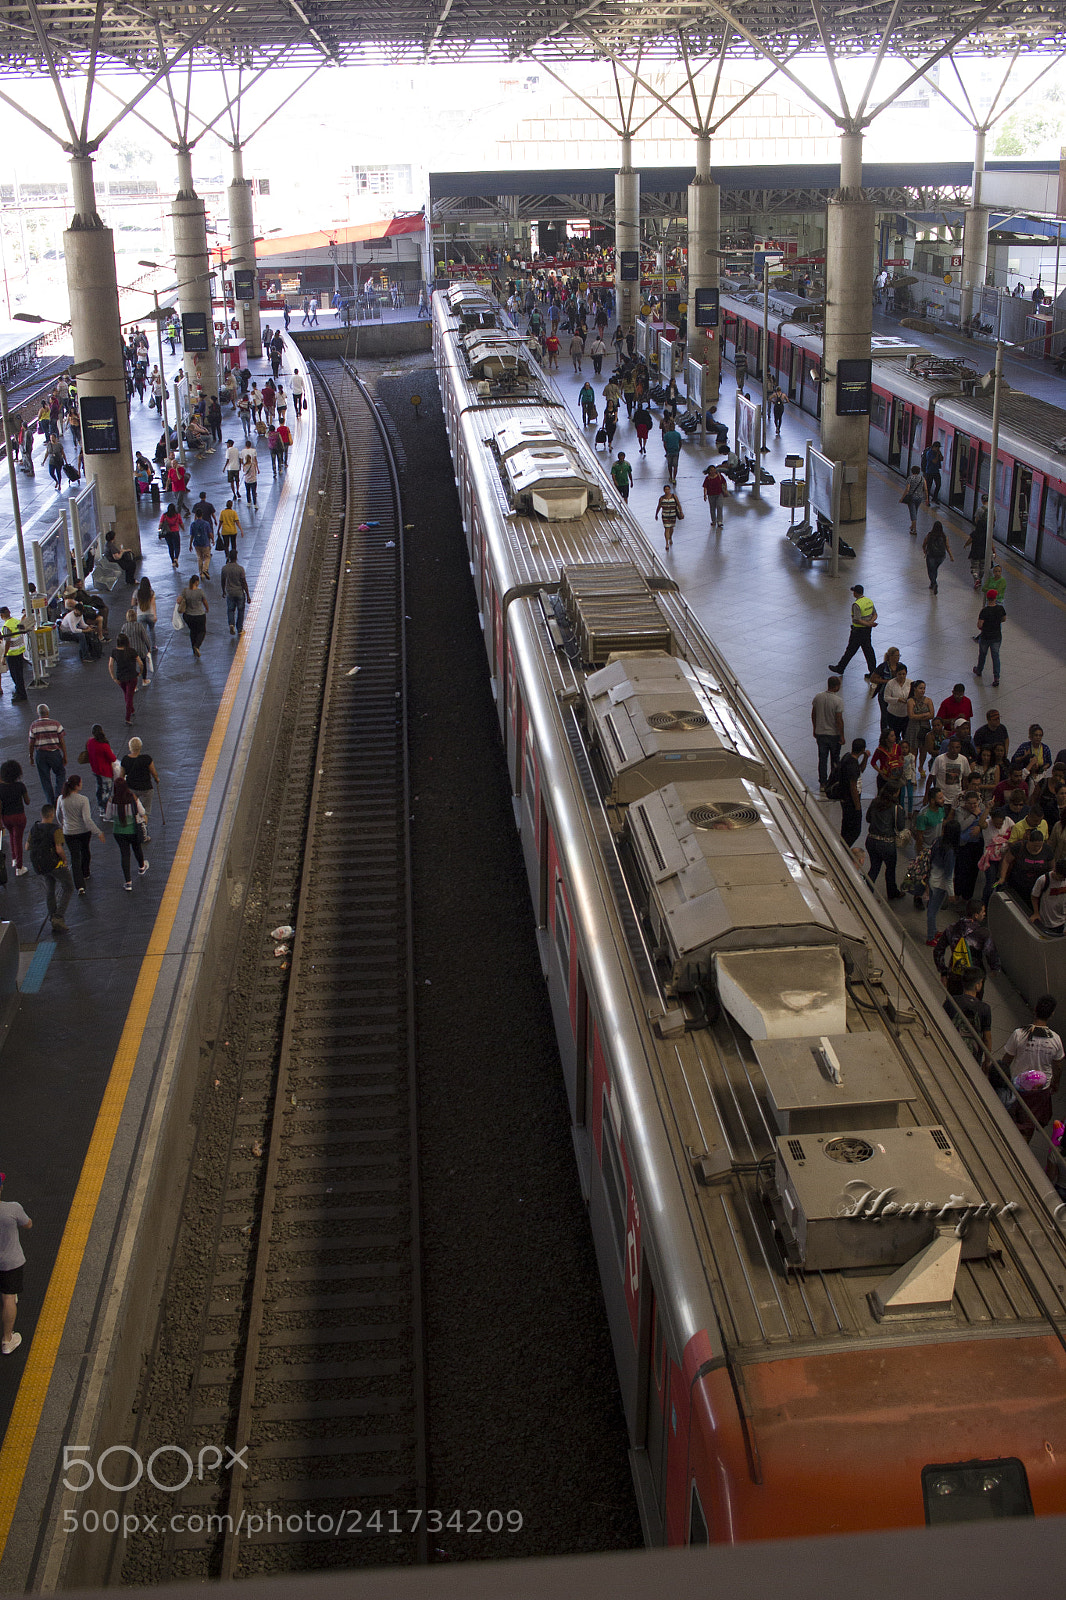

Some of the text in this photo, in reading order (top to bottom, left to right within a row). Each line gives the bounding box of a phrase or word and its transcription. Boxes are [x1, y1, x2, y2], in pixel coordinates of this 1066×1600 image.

[953, 257, 960, 266] 8
[606, 264, 612, 273] 6
[643, 263, 650, 271] 7
[261, 281, 268, 289] 5
